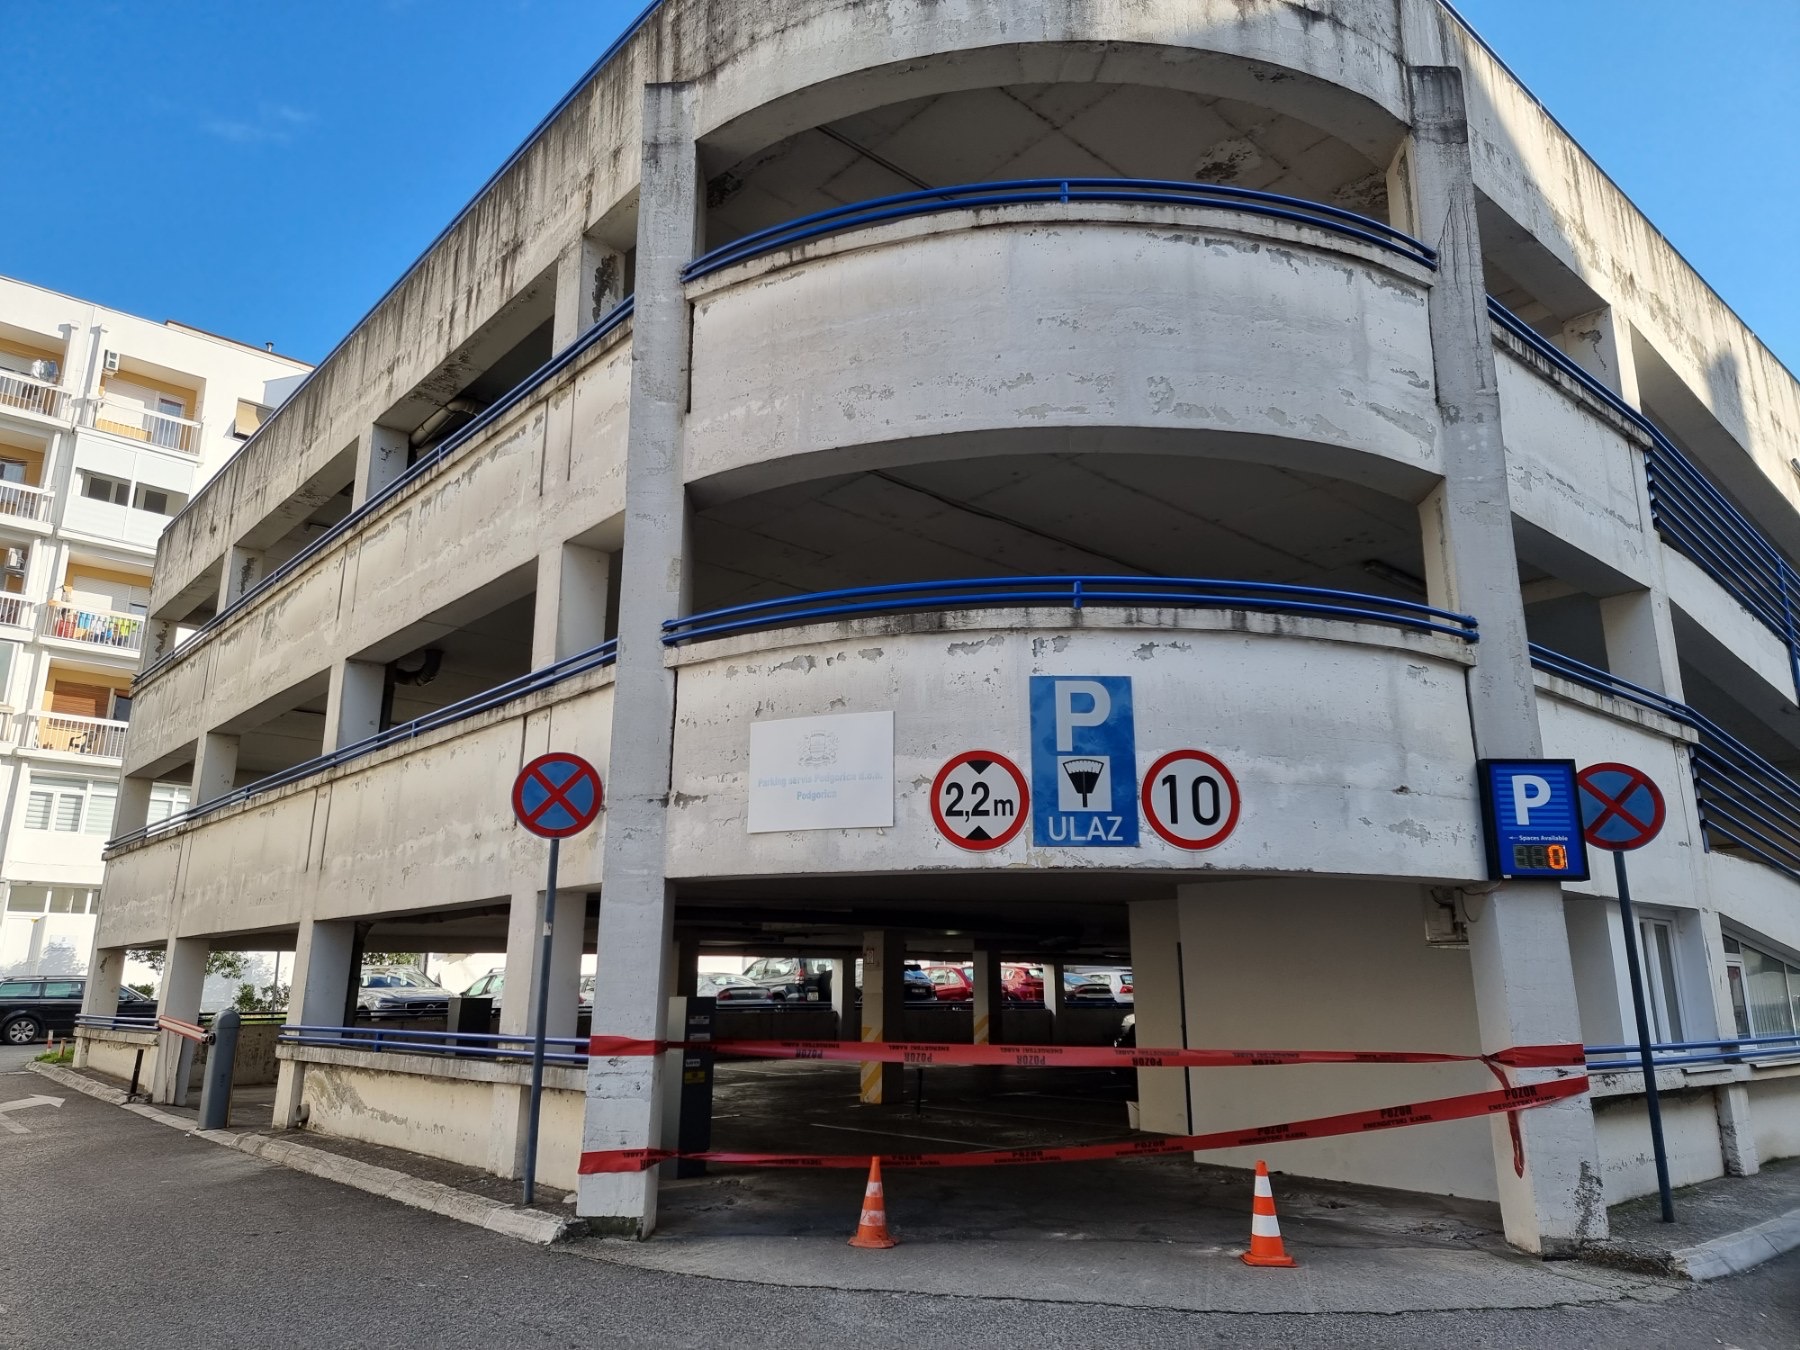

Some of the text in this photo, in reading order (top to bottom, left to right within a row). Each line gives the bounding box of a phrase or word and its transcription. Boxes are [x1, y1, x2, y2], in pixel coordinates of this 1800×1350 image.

[1055, 680, 1112, 752] P
[758, 775, 787, 788] Parking
[788, 774, 812, 785] servis
[815, 773, 857, 785] Podgorica
[796, 789, 837, 802] Podgorica
[1161, 774, 1220, 827] 10
[1511, 774, 1552, 826] P
[1048, 816, 1124, 842] ULAZ
[1540, 834, 1568, 842] Available
[1547, 843, 1566, 870] 0
[904, 1053, 933, 1063] POZOR
[1016, 1055, 1046, 1065] POZOR
[1132, 1057, 1162, 1067] POZOR
[1504, 1086, 1537, 1100] POZOR
[1380, 1105, 1413, 1119] POZOR
[1409, 1114, 1433, 1122] KABEL
[1257, 1124, 1289, 1136] POZOR
